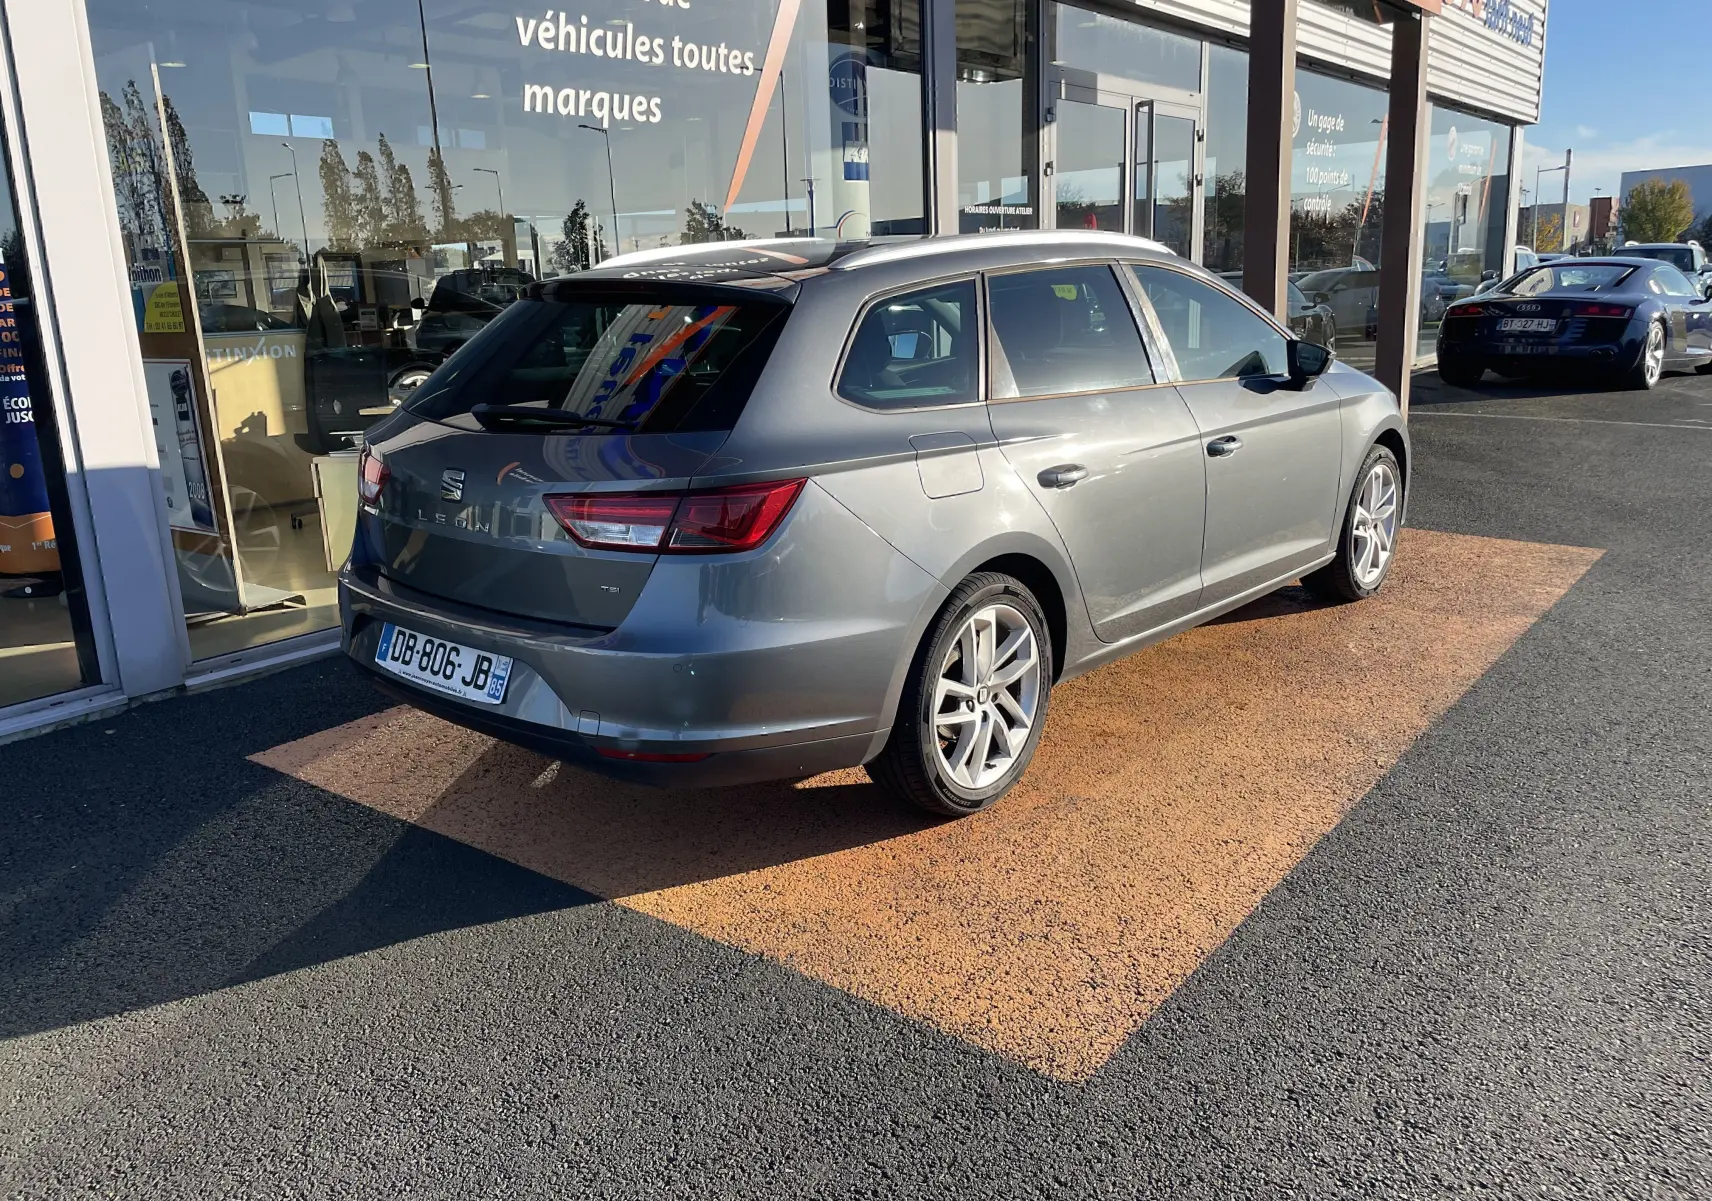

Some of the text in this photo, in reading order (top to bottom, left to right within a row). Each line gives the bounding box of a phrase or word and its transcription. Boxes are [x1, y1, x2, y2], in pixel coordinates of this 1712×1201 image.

[516, 10, 754, 75] véhicules toutes
[524, 84, 662, 128] marques
[1307, 109, 1345, 134] Un gage de
[1306, 166, 1349, 187] 100 points de
[964, 205, 1033, 216] HORAIRES OUVERTURE ATELIER
[1303, 194, 1332, 212] contrôle
[189, 481, 205, 500] 2008
[417, 508, 490, 534] LEON
[600, 585, 620, 594] TSI
[489, 678, 504, 697] 85
